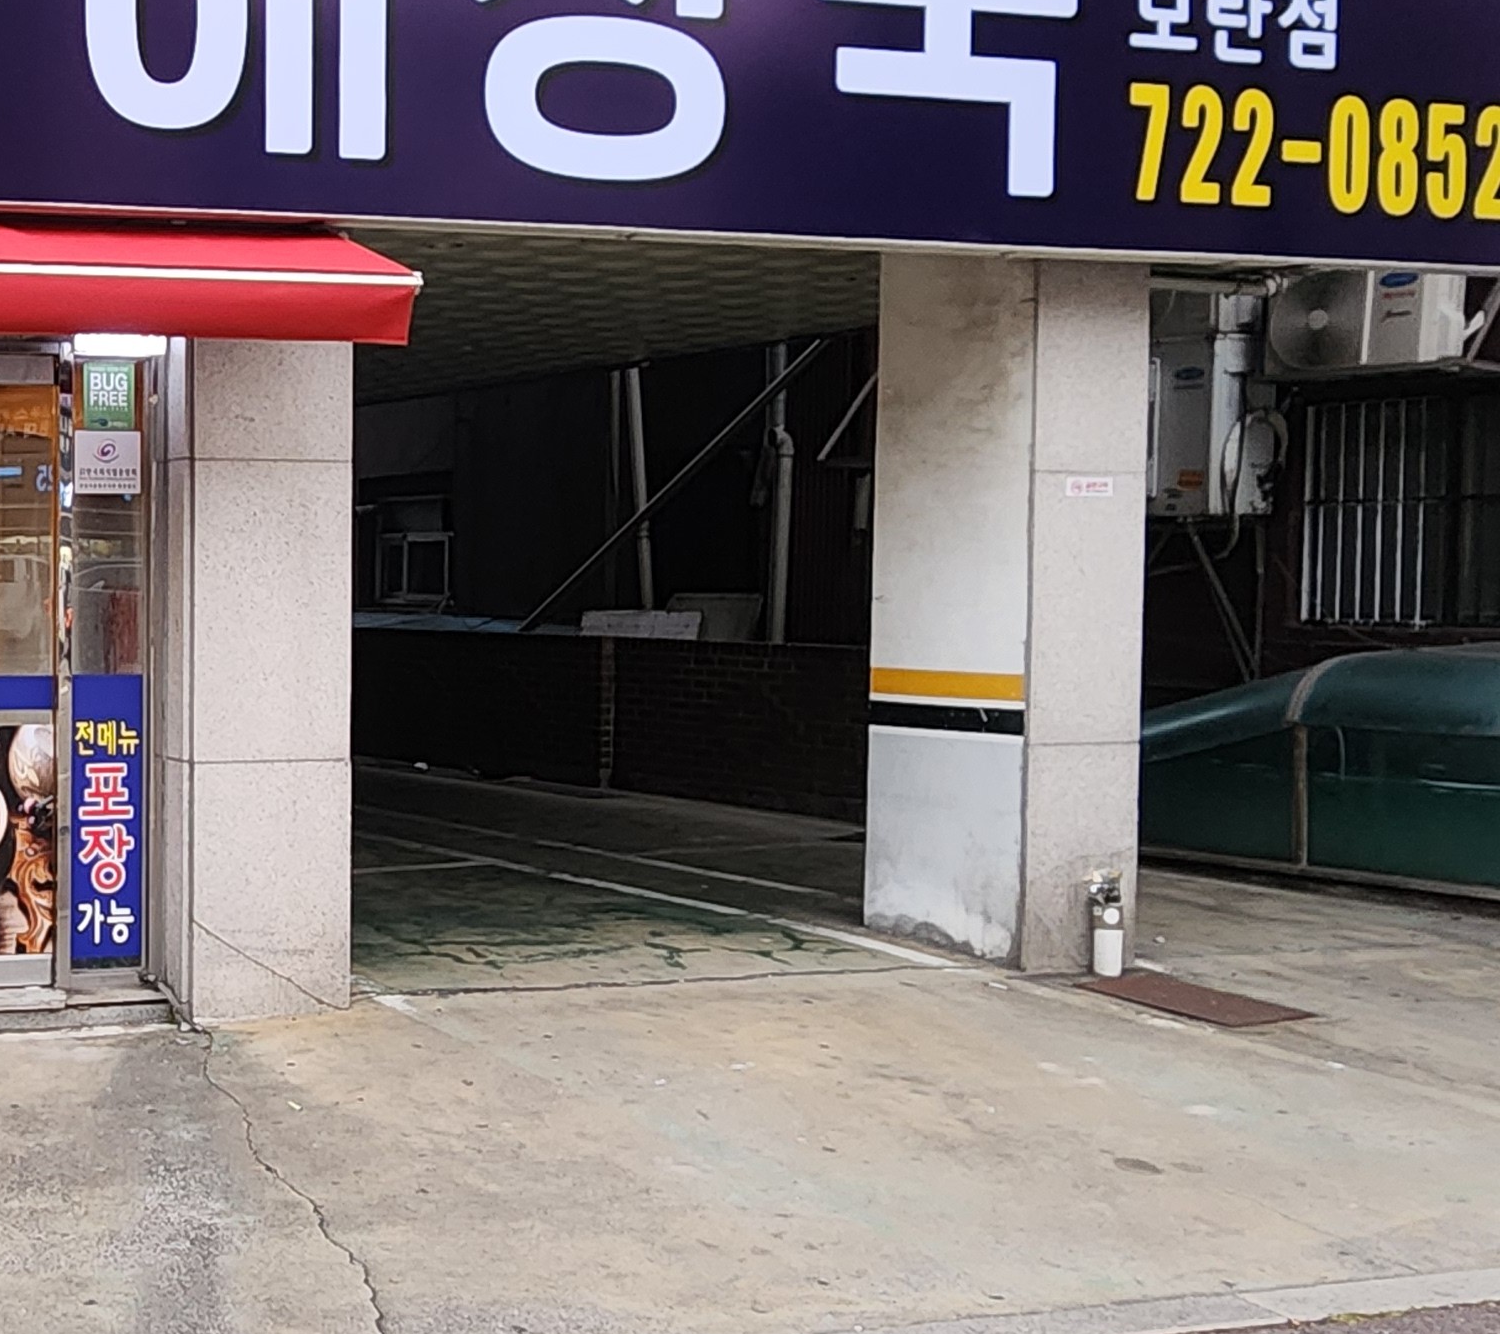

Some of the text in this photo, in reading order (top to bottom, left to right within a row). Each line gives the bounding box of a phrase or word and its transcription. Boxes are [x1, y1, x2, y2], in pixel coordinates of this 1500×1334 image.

[1128, 82, 1500, 219] 722-0852
[89, 372, 128, 390] BUG
[89, 391, 128, 407] FREE
[74, 720, 140, 756] 전메뉴
[78, 762, 136, 895] 포장
[76, 898, 136, 945] 가능
